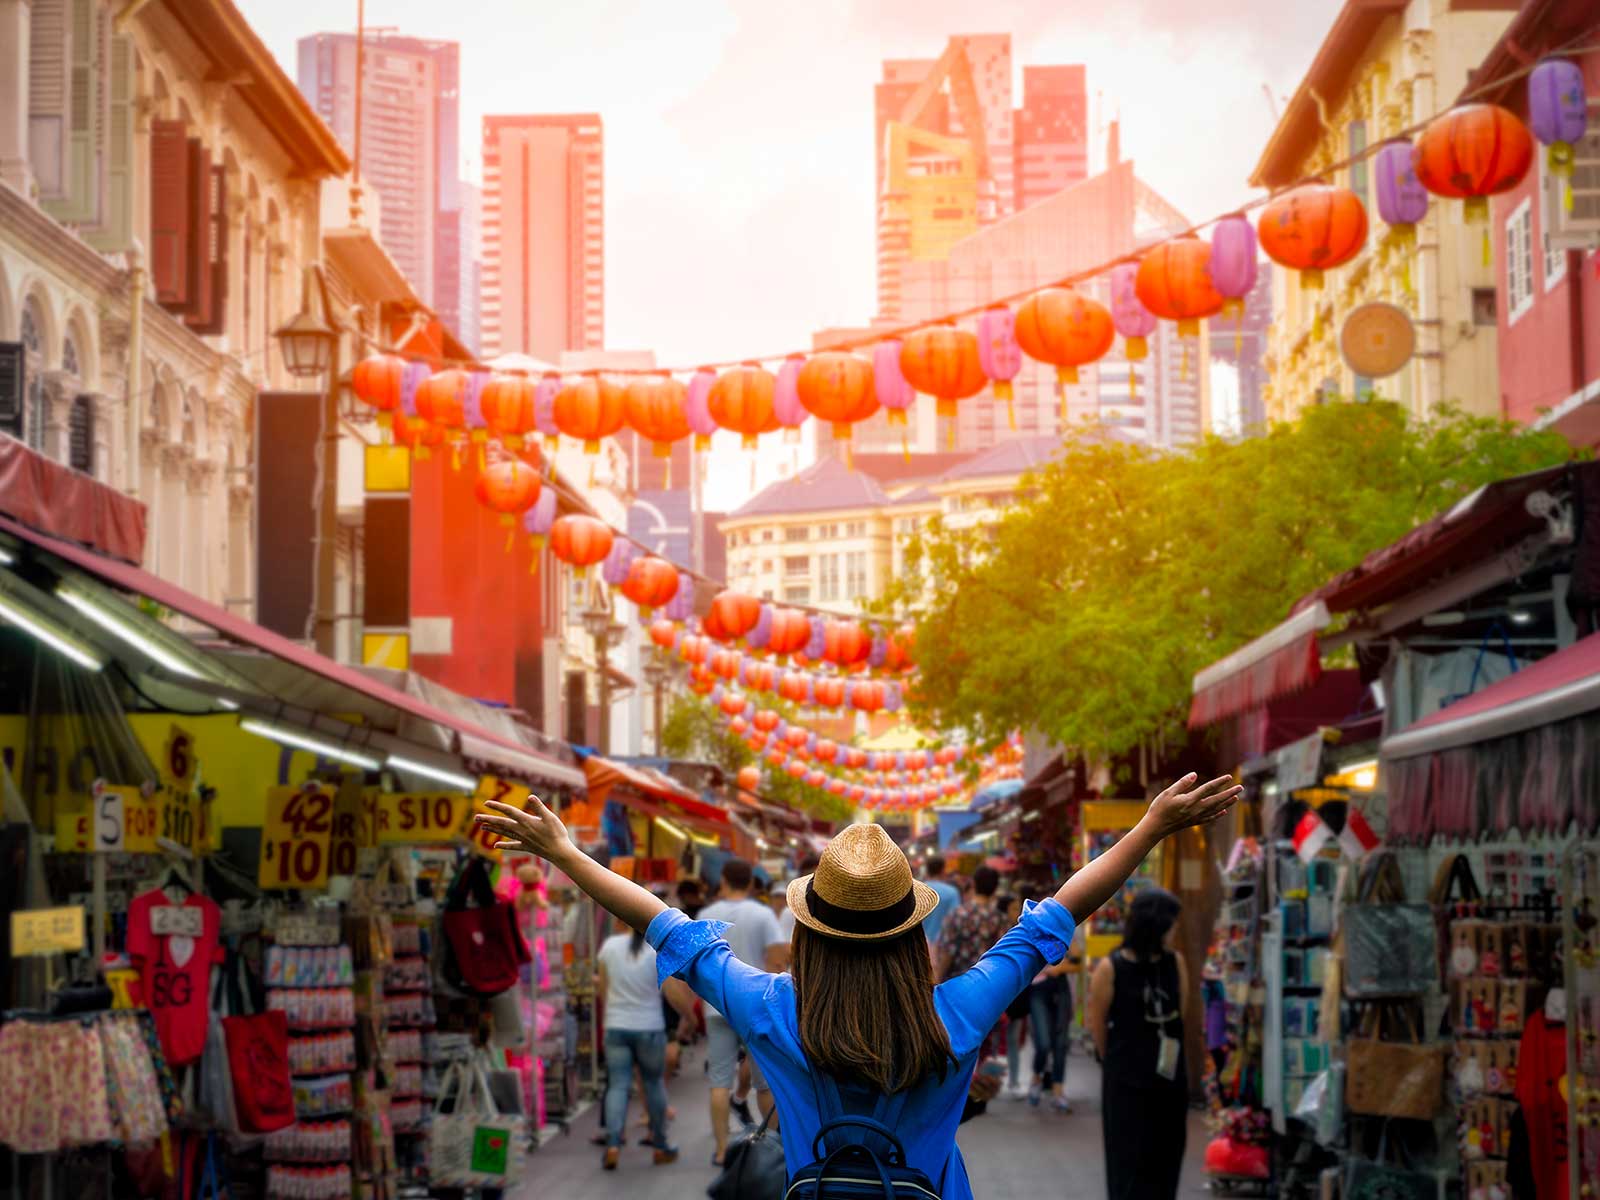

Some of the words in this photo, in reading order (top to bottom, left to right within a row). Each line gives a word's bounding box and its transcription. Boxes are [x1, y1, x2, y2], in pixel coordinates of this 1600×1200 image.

[171, 736, 188, 779] 6
[100, 796, 121, 846] 5
[126, 806, 157, 838] FOR
[283, 793, 332, 835] 42
[399, 797, 452, 829] $10
[265, 839, 322, 882] $10
[152, 971, 193, 1008] SG
